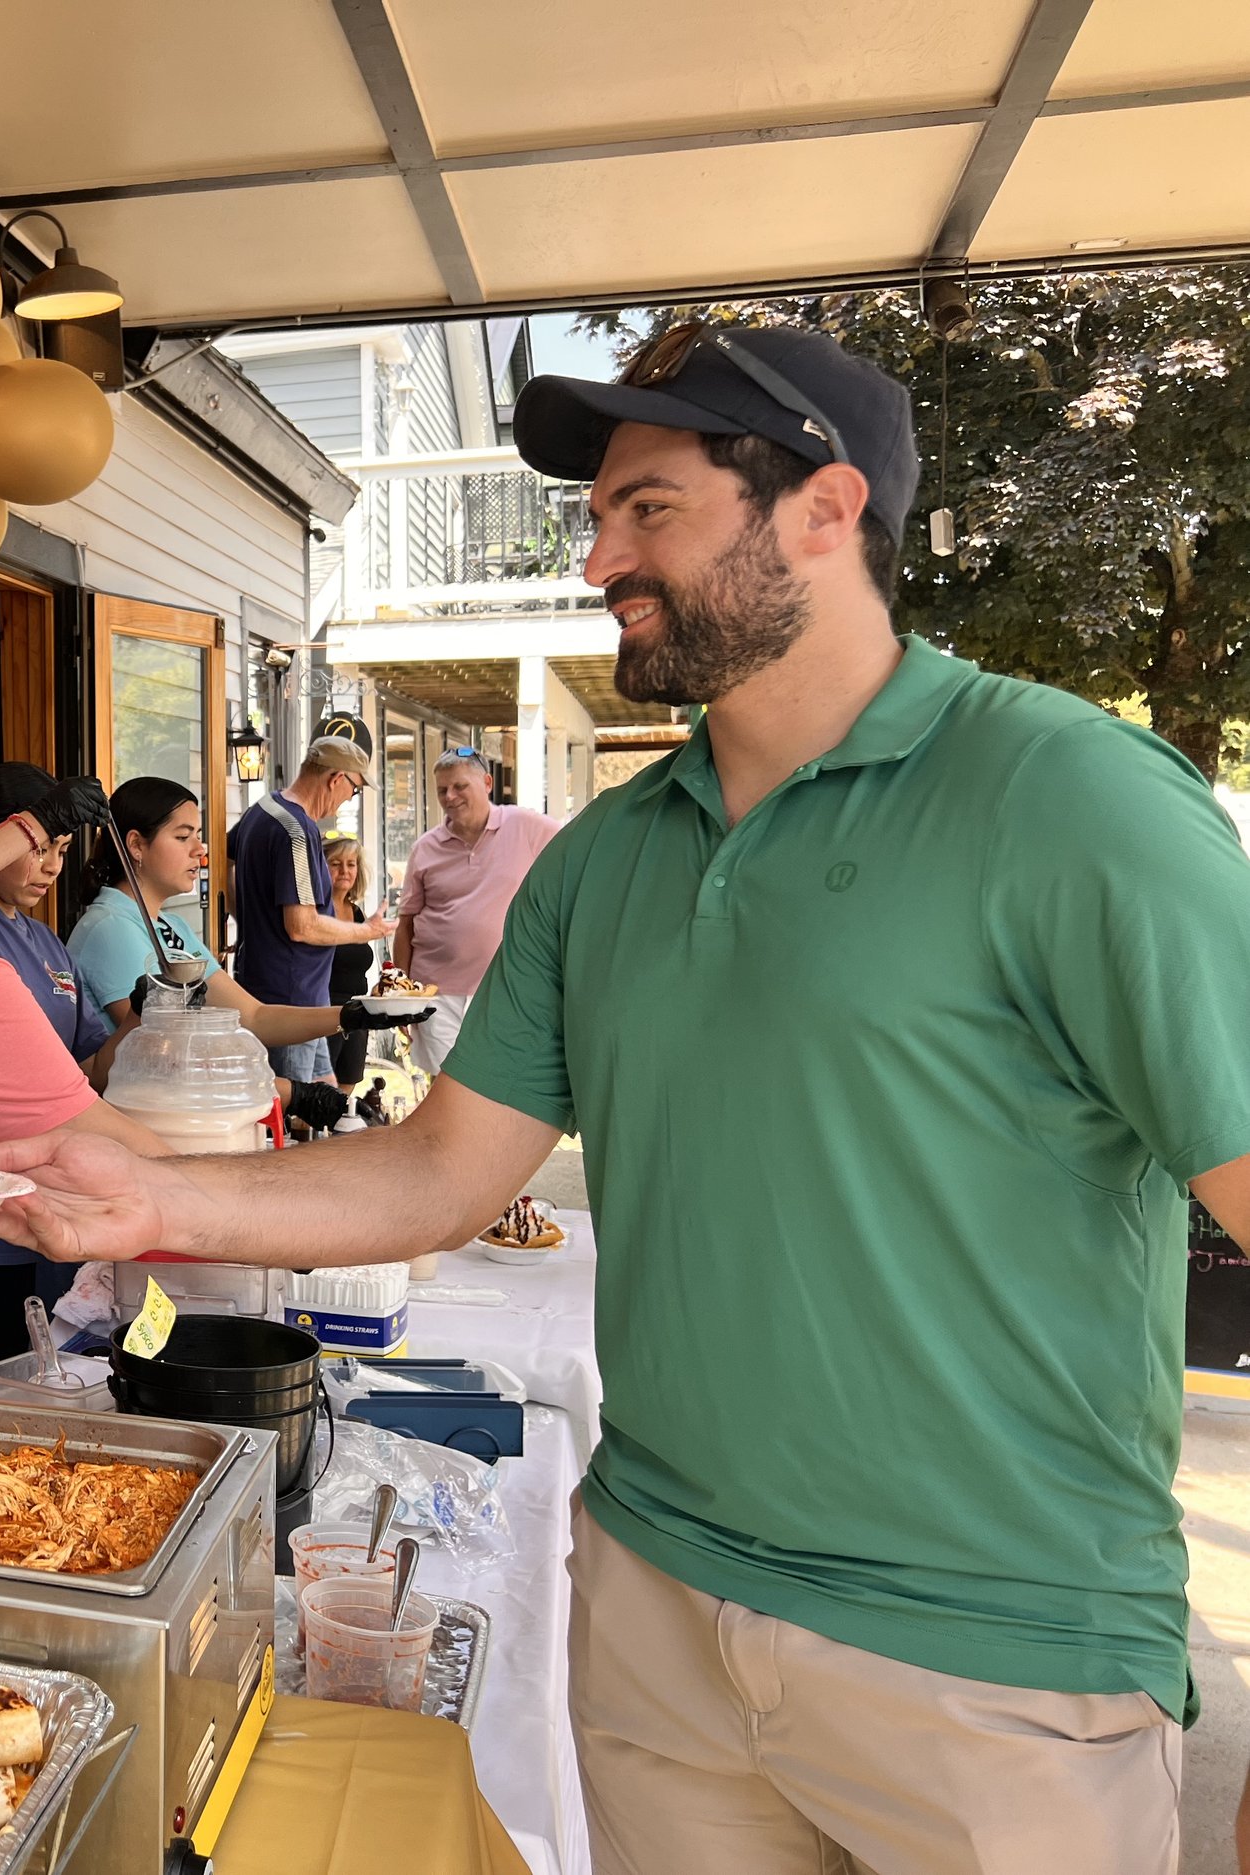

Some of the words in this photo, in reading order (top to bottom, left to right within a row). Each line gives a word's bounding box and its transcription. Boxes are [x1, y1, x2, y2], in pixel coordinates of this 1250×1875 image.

[137, 1322, 154, 1350] Sysco
[325, 1323, 354, 1333] DRINKING
[354, 1327, 380, 1335] STRAWS
